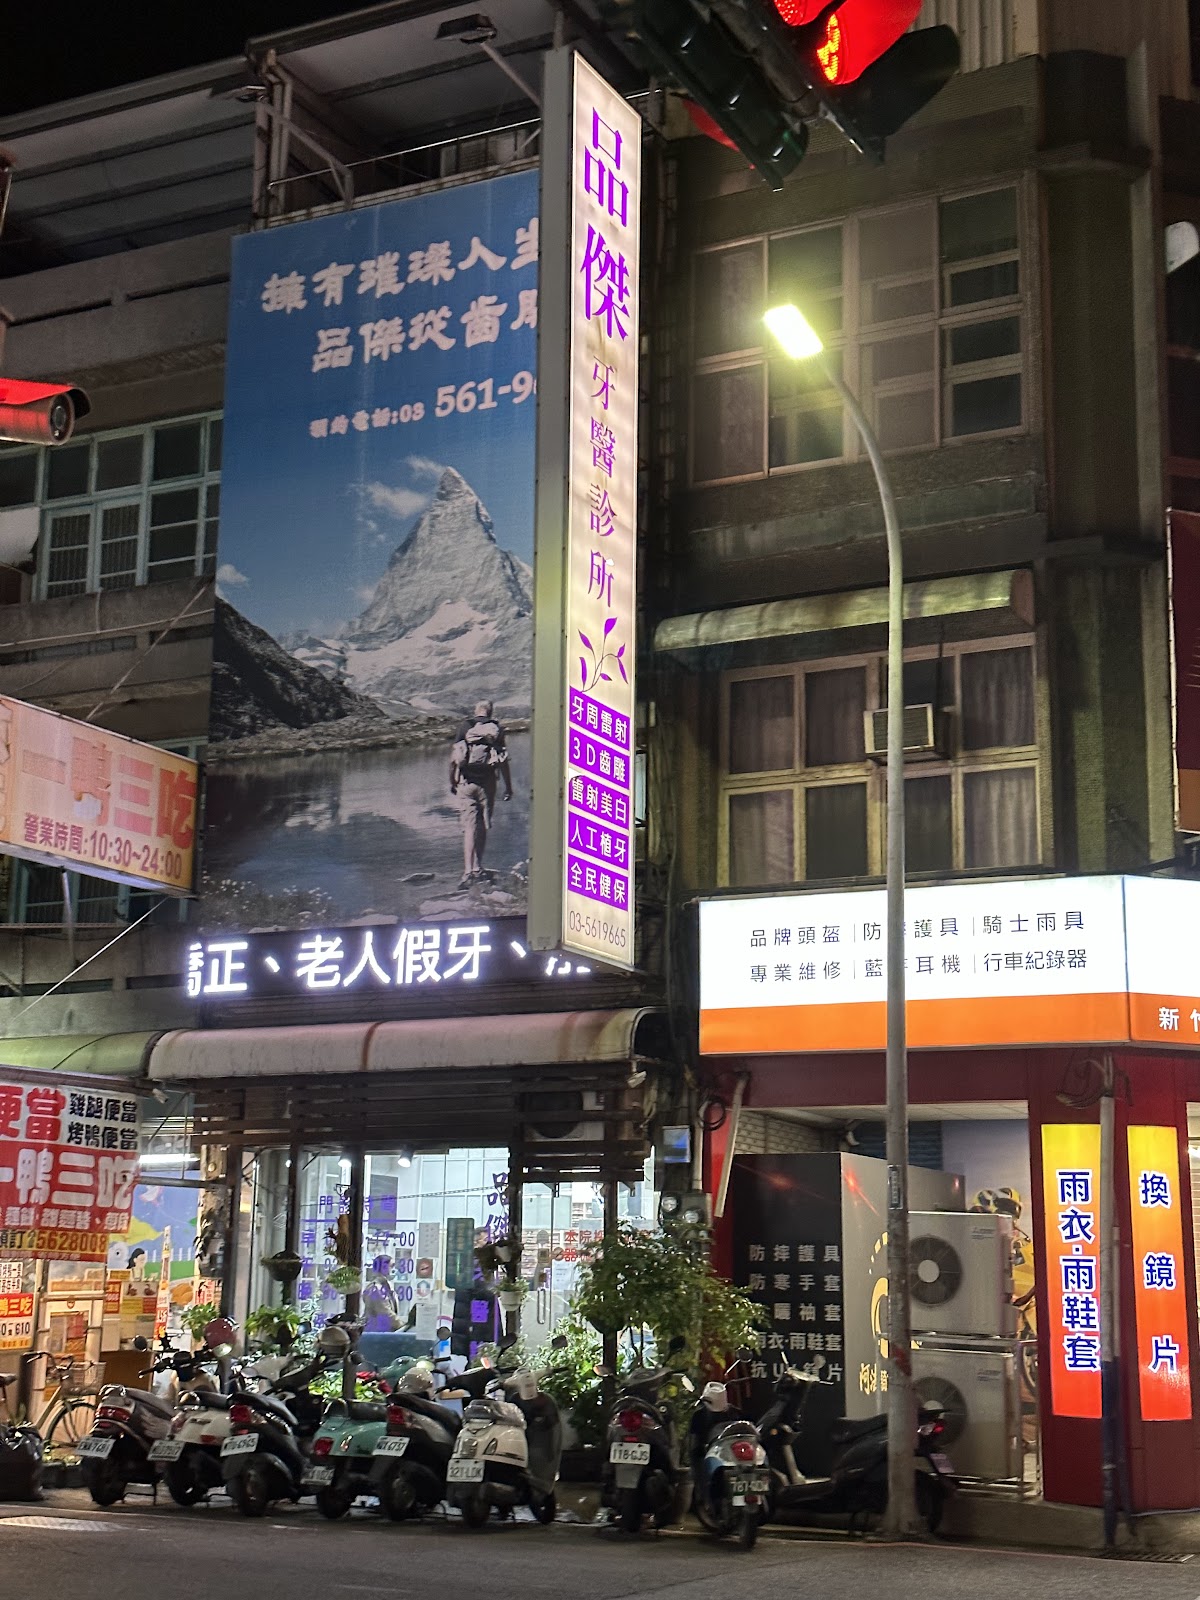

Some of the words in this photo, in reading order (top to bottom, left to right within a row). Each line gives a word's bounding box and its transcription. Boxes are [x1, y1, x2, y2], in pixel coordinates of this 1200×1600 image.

[580, 107, 630, 342] 品傑
[434, 370, 537, 417] 561-9
[587, 356, 617, 607] 牙醫診所
[571, 695, 628, 744] 牙周雷射
[571, 778, 627, 824] 雷射美白
[571, 819, 626, 863] 人工植牙
[570, 862, 626, 904] 全民健保
[569, 911, 626, 947] 03-5619665
[750, 925, 841, 947] 品牌頭盔
[863, 917, 959, 941] 防護具
[983, 911, 1085, 934] 騎士雨具
[188, 926, 591, 996] 正、老人假牙、
[750, 960, 842, 983] 專業維修
[864, 954, 961, 977] 藍耳機
[983, 949, 1087, 971] 行車紀錄器
[749, 1273, 842, 1292] 防寒手套
[1140, 1172, 1179, 1371] 換鏡片
[772, 1302, 842, 1322] 暖袖套
